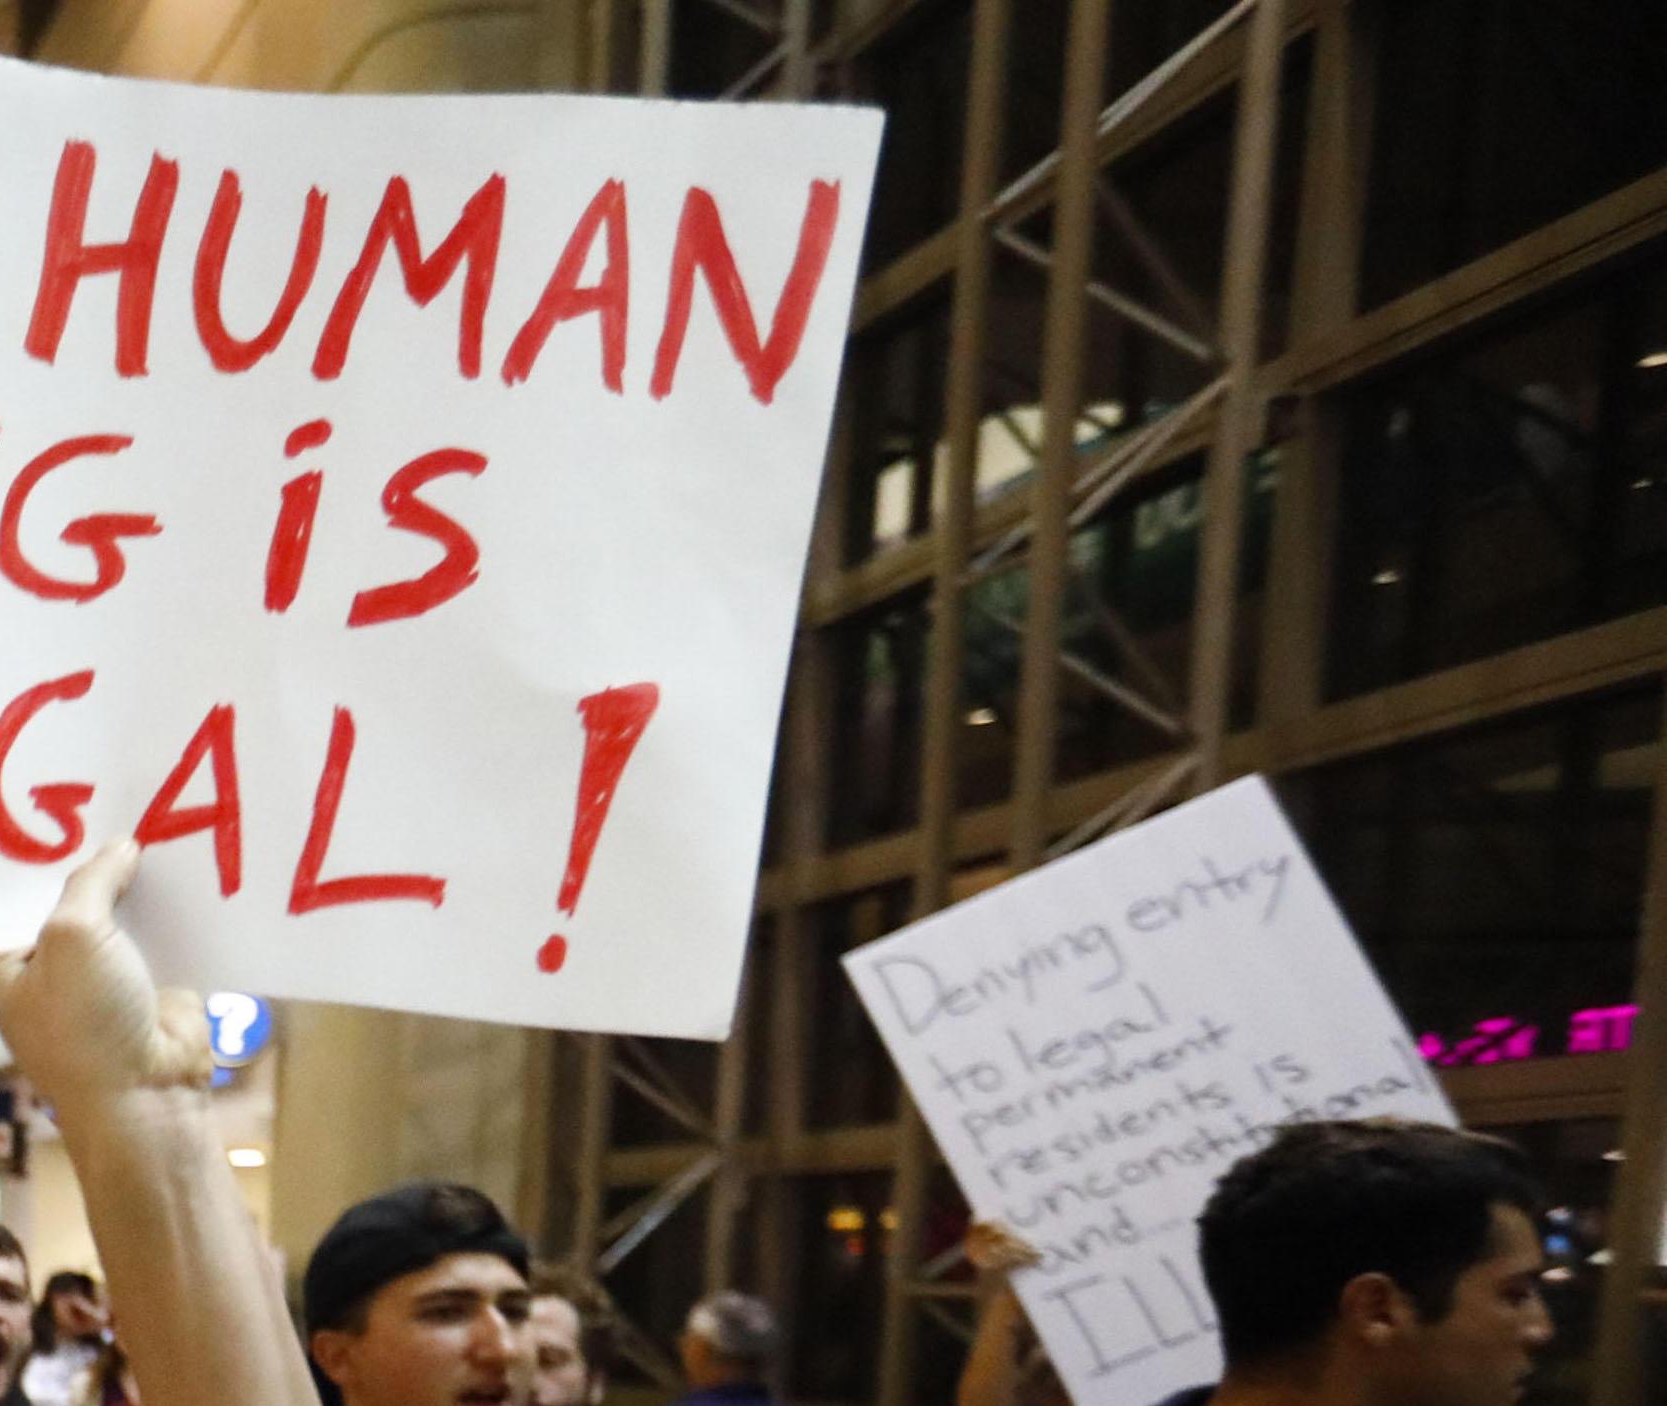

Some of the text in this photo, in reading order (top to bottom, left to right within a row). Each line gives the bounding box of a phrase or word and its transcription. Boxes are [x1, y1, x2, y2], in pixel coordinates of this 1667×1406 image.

[27, 142, 838, 403] HUMAN
[873, 856, 1289, 1036] Denying entry
[929, 982, 1169, 1100] to legal
[961, 1017, 1233, 1156] permanent
[985, 1080, 1231, 1191] residents
[1037, 1205, 1143, 1277] and
